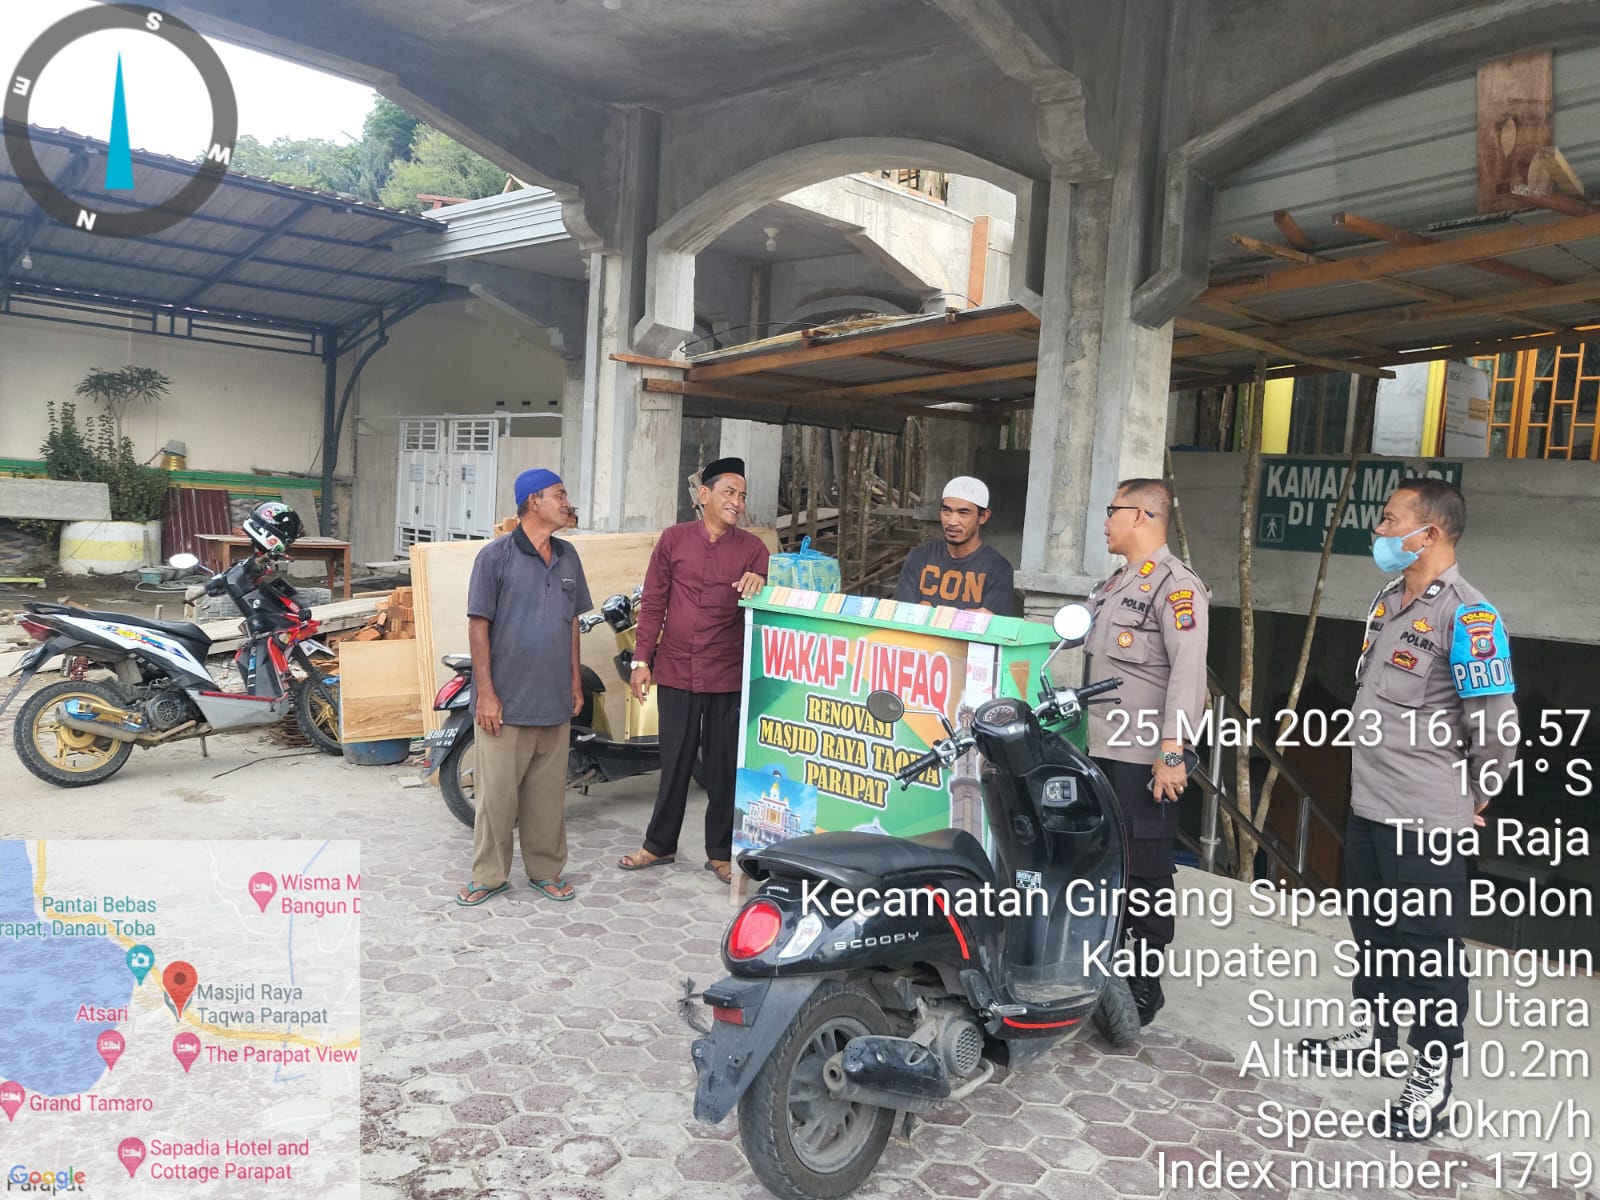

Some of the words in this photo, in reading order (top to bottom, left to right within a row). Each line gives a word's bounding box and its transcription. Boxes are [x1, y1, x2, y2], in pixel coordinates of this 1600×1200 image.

[1288, 501, 1313, 527] DI
[919, 563, 987, 604] CON
[1400, 630, 1435, 652] POLRI
[763, 627, 847, 688] WAKAF
[871, 645, 949, 717] INFAQ
[759, 717, 819, 753] MASJID
[820, 731, 868, 769] RAYA
[806, 762, 888, 806] PARAPAT
[833, 931, 919, 951] SCOOPY
